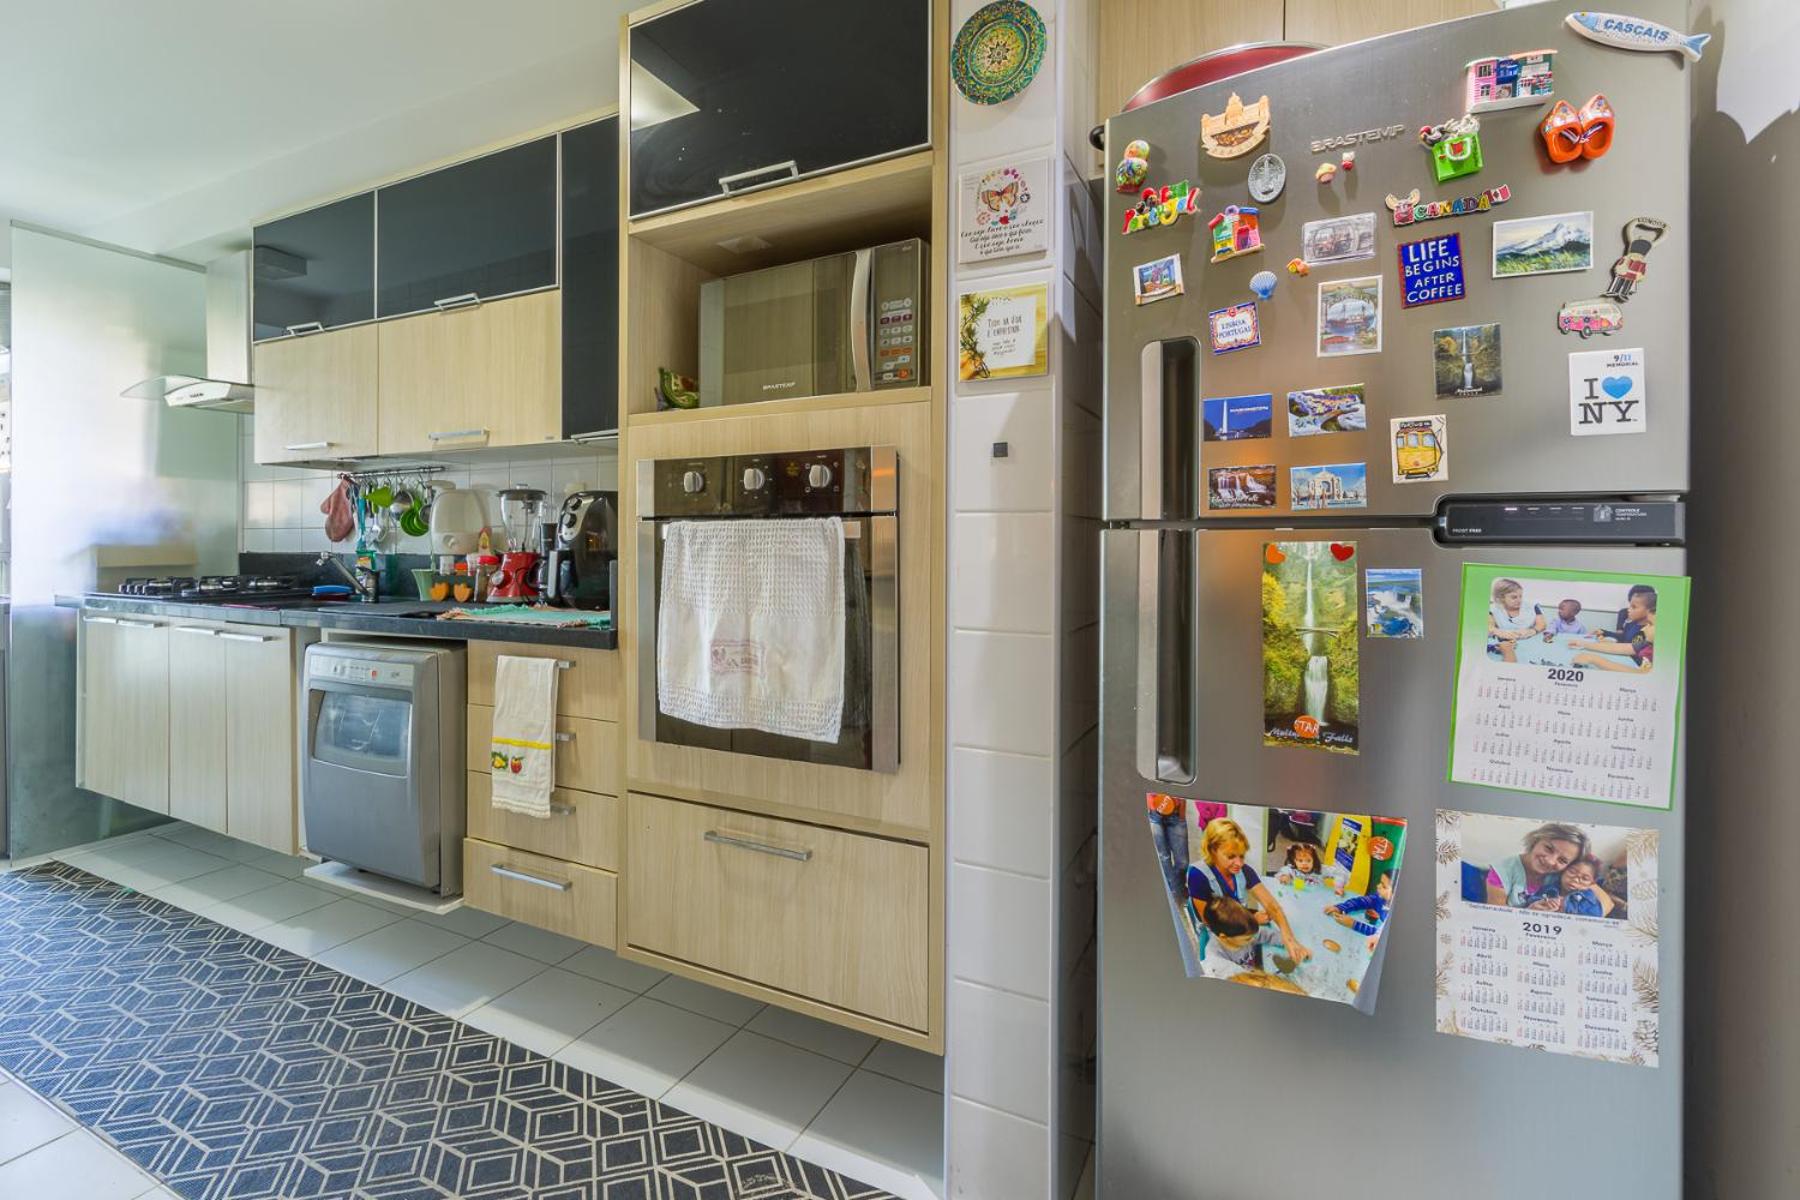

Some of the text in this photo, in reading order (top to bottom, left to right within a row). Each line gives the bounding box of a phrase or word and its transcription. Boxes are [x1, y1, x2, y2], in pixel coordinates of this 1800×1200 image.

[1603, 18, 1670, 41] CASCAIS
[1311, 124, 1404, 153] BRASTEMP
[1414, 194, 1491, 220] CANADA
[1408, 238, 1449, 262] LIFE
[1405, 255, 1459, 277] BEGINS
[1414, 272, 1455, 288] AFTER
[1407, 284, 1462, 302] COFFEE
[1613, 353, 1632, 361] 9/11
[1583, 378, 1599, 400] I
[1578, 400, 1639, 424] NY
[1547, 668, 1584, 682] 2020
[1522, 921, 1563, 936] 2019
